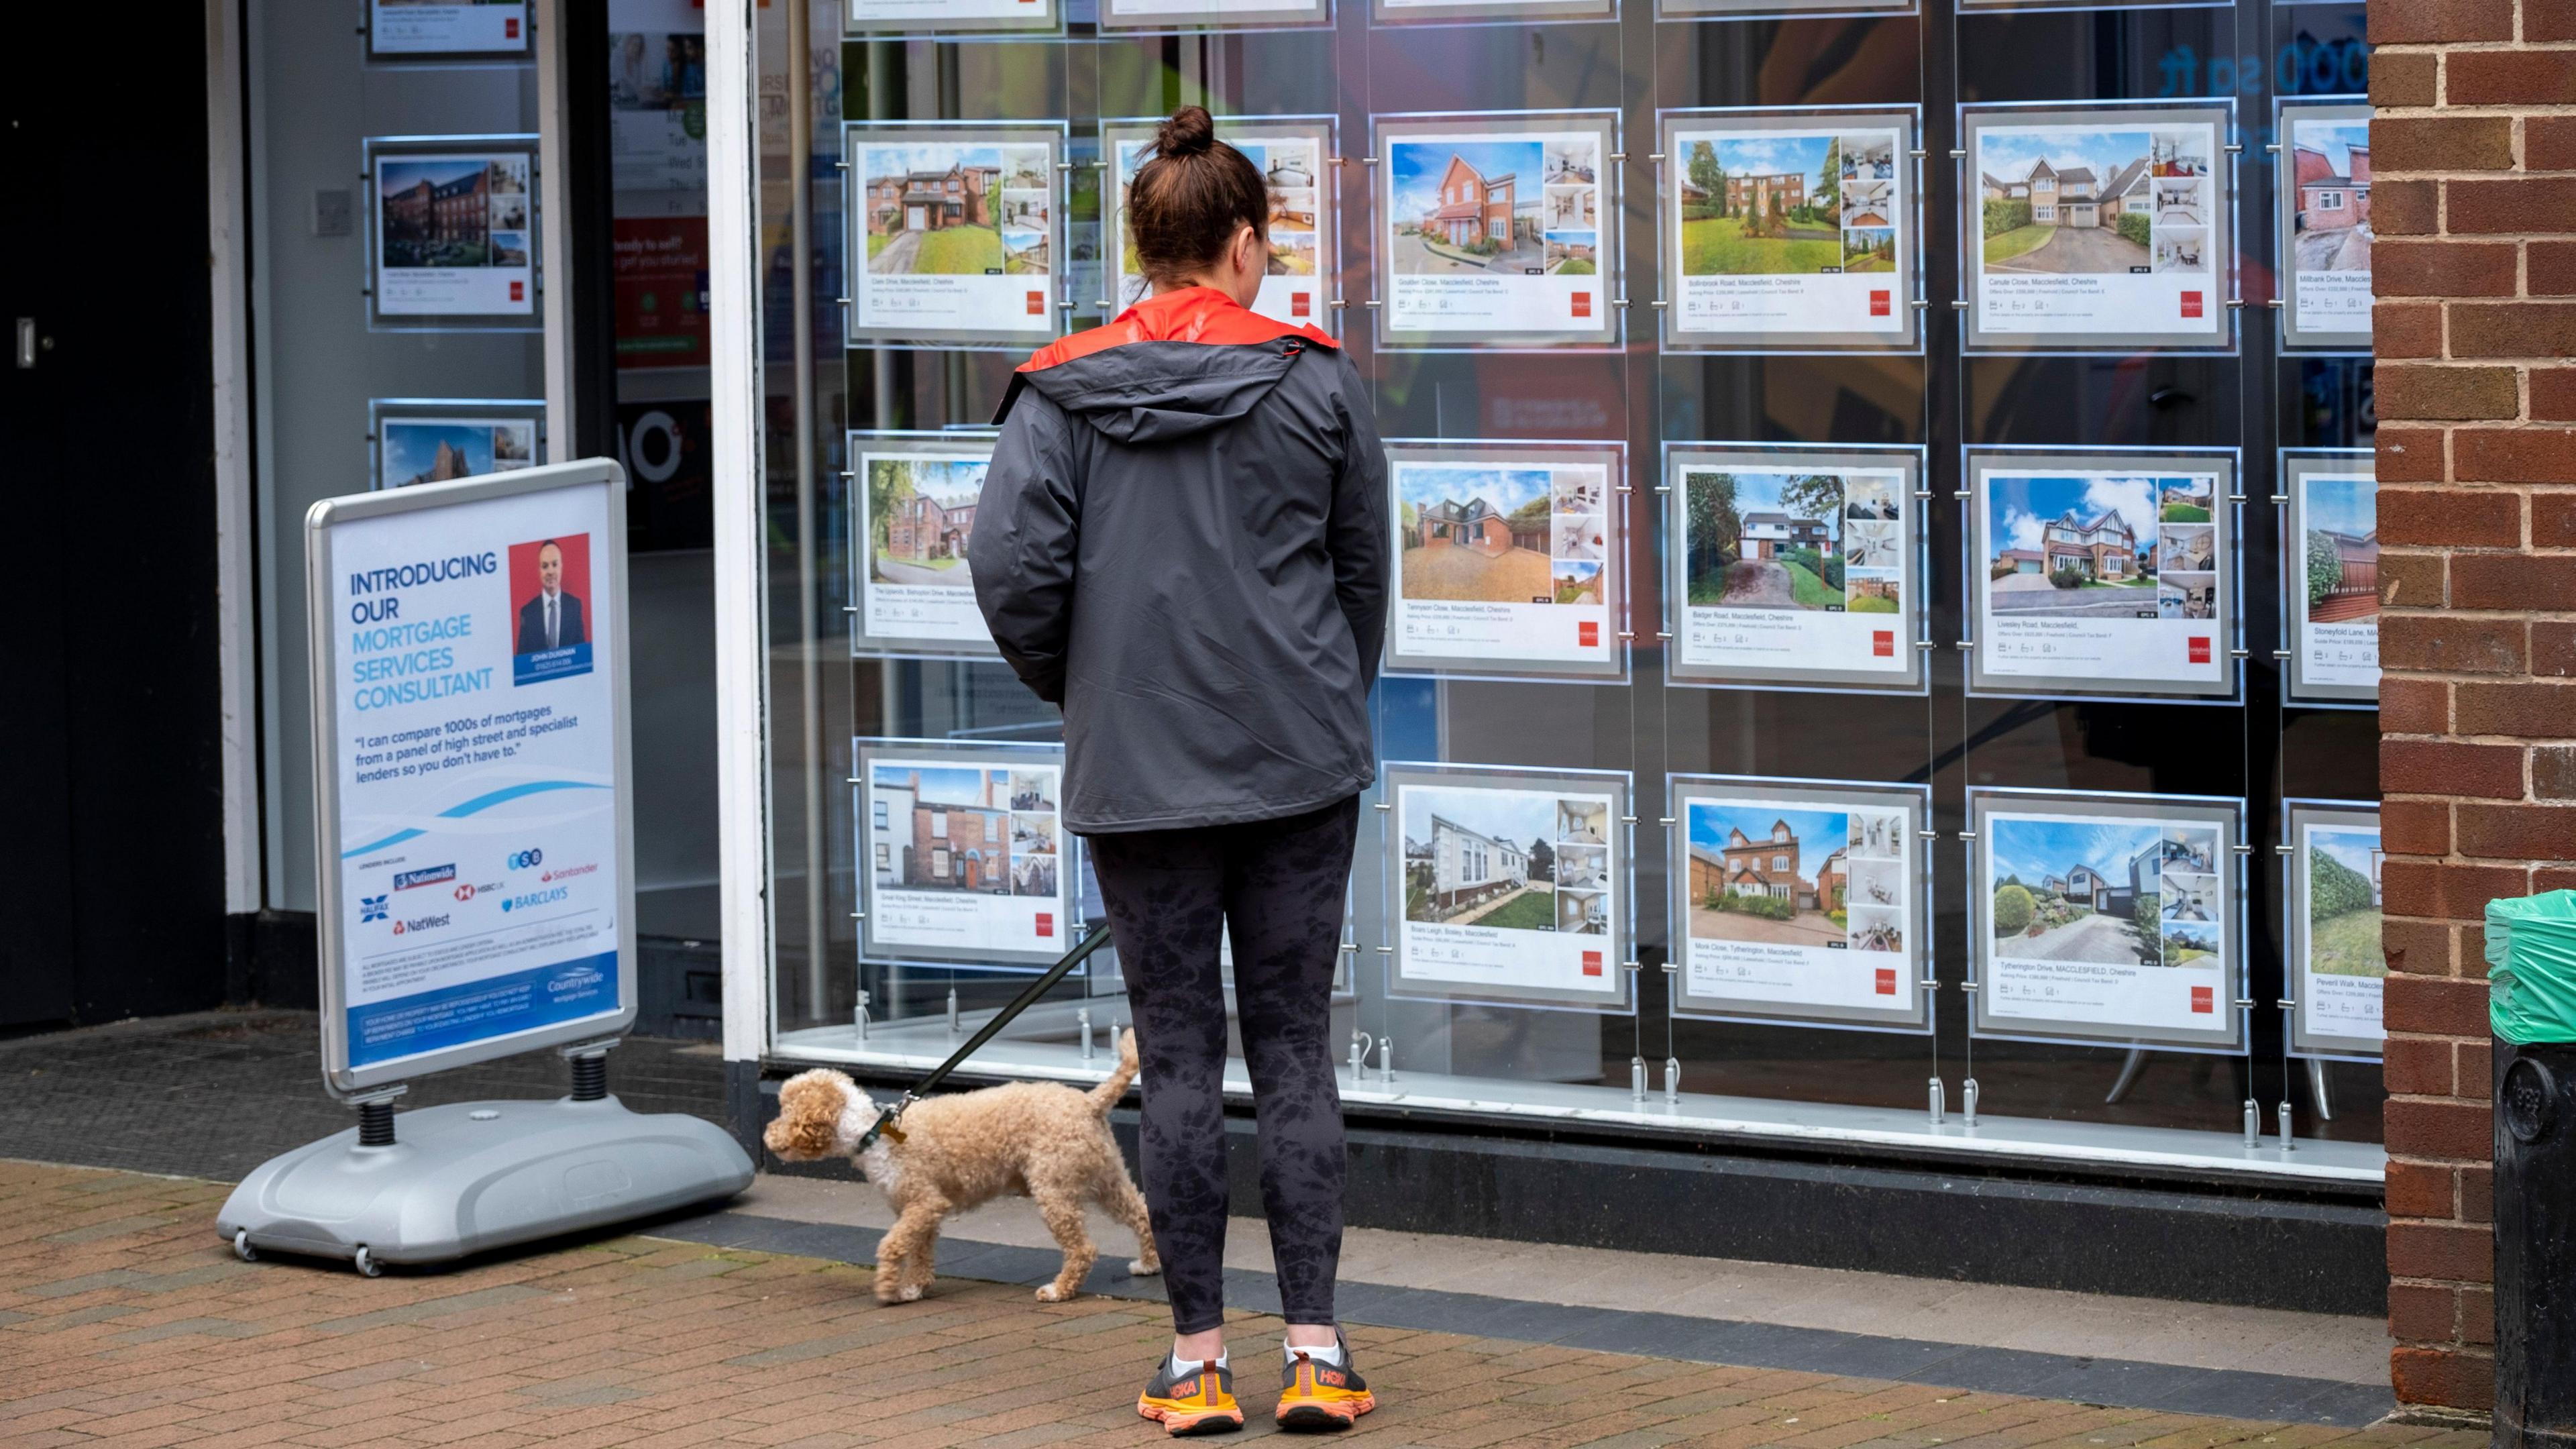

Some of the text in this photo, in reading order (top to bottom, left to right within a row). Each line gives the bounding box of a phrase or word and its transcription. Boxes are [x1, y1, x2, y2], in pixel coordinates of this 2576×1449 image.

[2326, 275, 2344, 283] Drive,
[350, 551, 497, 596] INTRODUCING
[351, 597, 399, 625] OUR
[1693, 610, 1713, 619] Badger
[1713, 611, 1731, 619] Road,
[1768, 614, 1794, 622] Cheshire
[1998, 620, 2021, 628] Livesley
[2314, 628, 2348, 637] Stoneyfold
[352, 614, 472, 655] MORTGAGE
[353, 647, 454, 684] SERVICES
[354, 667, 494, 711] CONSULTANT
[368, 734, 388, 748] can
[391, 725, 441, 745] compare
[444, 719, 479, 734] 1000s
[480, 714, 492, 728] of
[494, 705, 552, 727] mortgages
[356, 716, 578, 767] from a panel of high street and specialist
[356, 766, 400, 784] lenders
[402, 763, 417, 775] so
[418, 760, 441, 777] you
[443, 753, 472, 770] don't
[473, 747, 500, 763] have
[508, 849, 543, 871] TSB
[409, 867, 455, 885] Nationwide
[553, 863, 598, 882] Santander
[477, 883, 495, 894] HSBC
[515, 886, 569, 910] BARCLAYS
[360, 903, 390, 915] HALIFAX
[407, 913, 451, 932] NatWest
[1465, 930, 1499, 938] Macclesfield
[1711, 943, 1729, 952] Close,
[1731, 945, 1766, 956] Tytherington,
[1767, 949, 1804, 957] Macclesfield
[2001, 961, 2137, 977] Tytherington Drive, MACCLESFIELD, Cheshire
[547, 971, 604, 994] Countrywide
[2316, 978, 2339, 987] Peveril
[1169, 1381, 1197, 1400] HOKA
